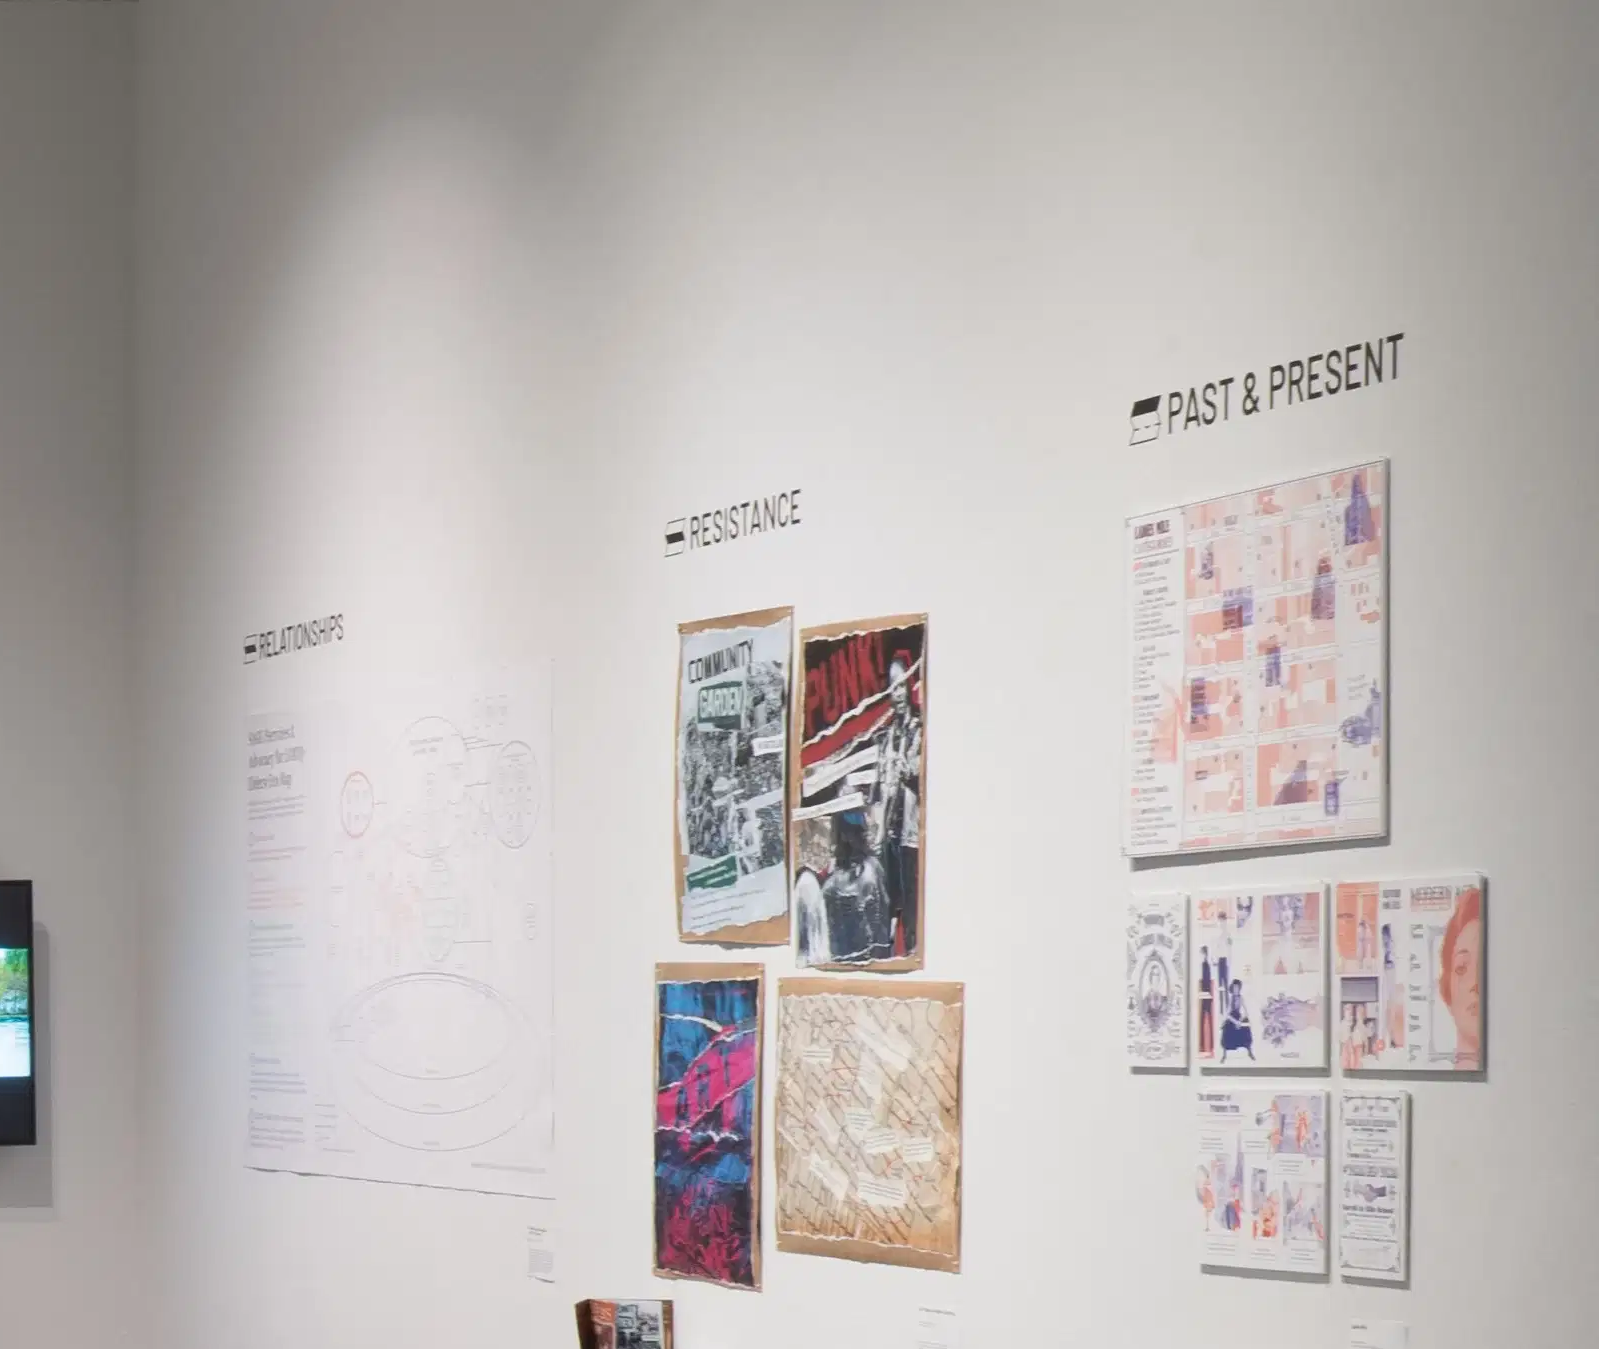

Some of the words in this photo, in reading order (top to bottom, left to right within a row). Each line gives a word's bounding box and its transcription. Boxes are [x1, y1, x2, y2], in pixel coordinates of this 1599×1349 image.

[1168, 377, 1235, 435] PAST
[1242, 370, 1260, 416] &
[1269, 332, 1405, 411] PRESENT
[689, 488, 802, 551] RESISTANCE
[259, 612, 345, 661] RELATIONSHIPS
[688, 637, 754, 684] COMMUNITY
